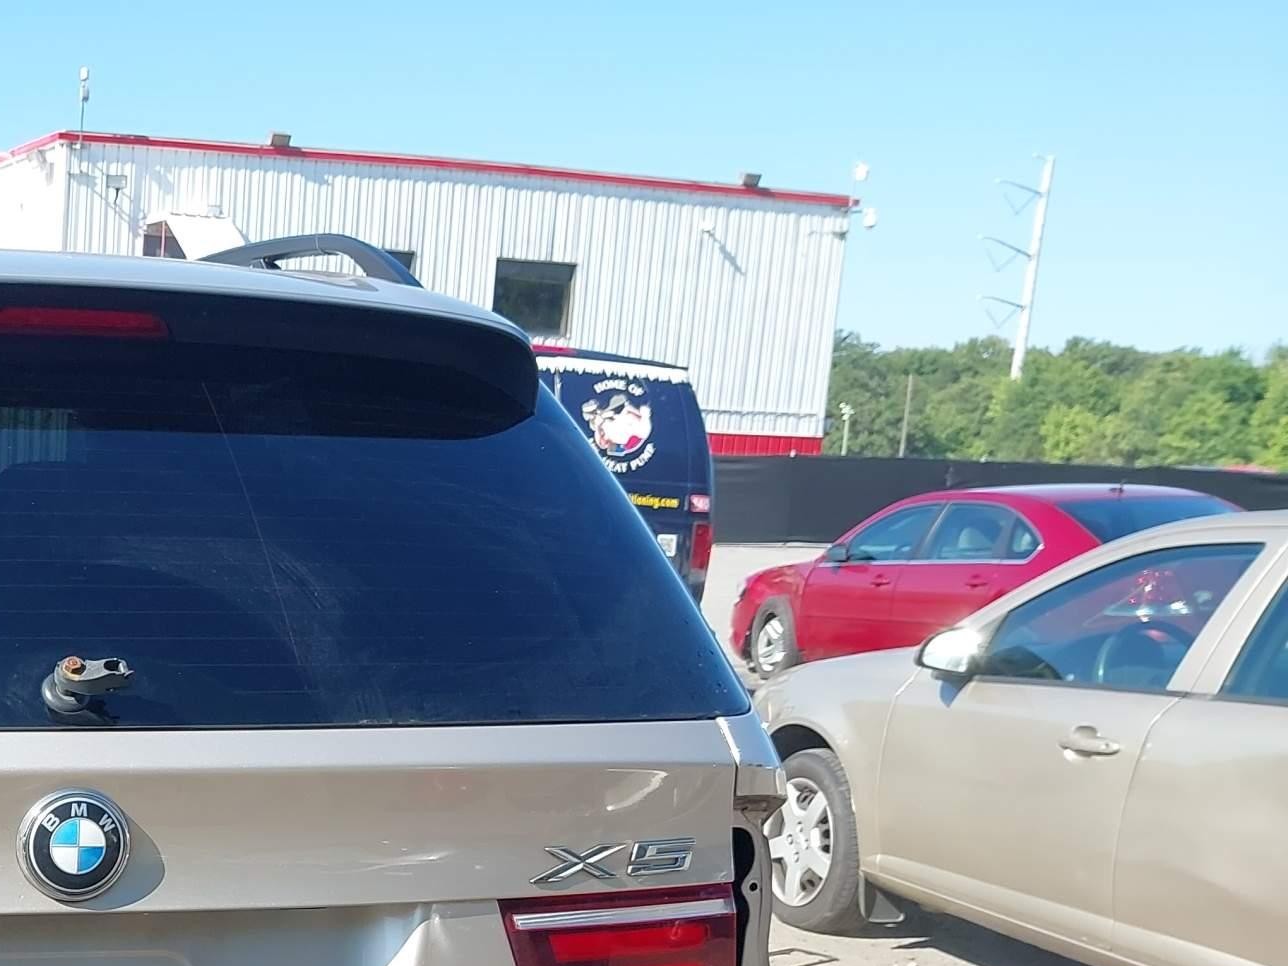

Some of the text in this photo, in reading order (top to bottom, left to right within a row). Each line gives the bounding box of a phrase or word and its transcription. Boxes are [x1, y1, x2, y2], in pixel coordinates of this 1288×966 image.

[593, 379, 644, 396] HOME OF
[630, 441, 656, 471] PUMP
[41, 803, 116, 832] BMW
[529, 837, 696, 884] X5
